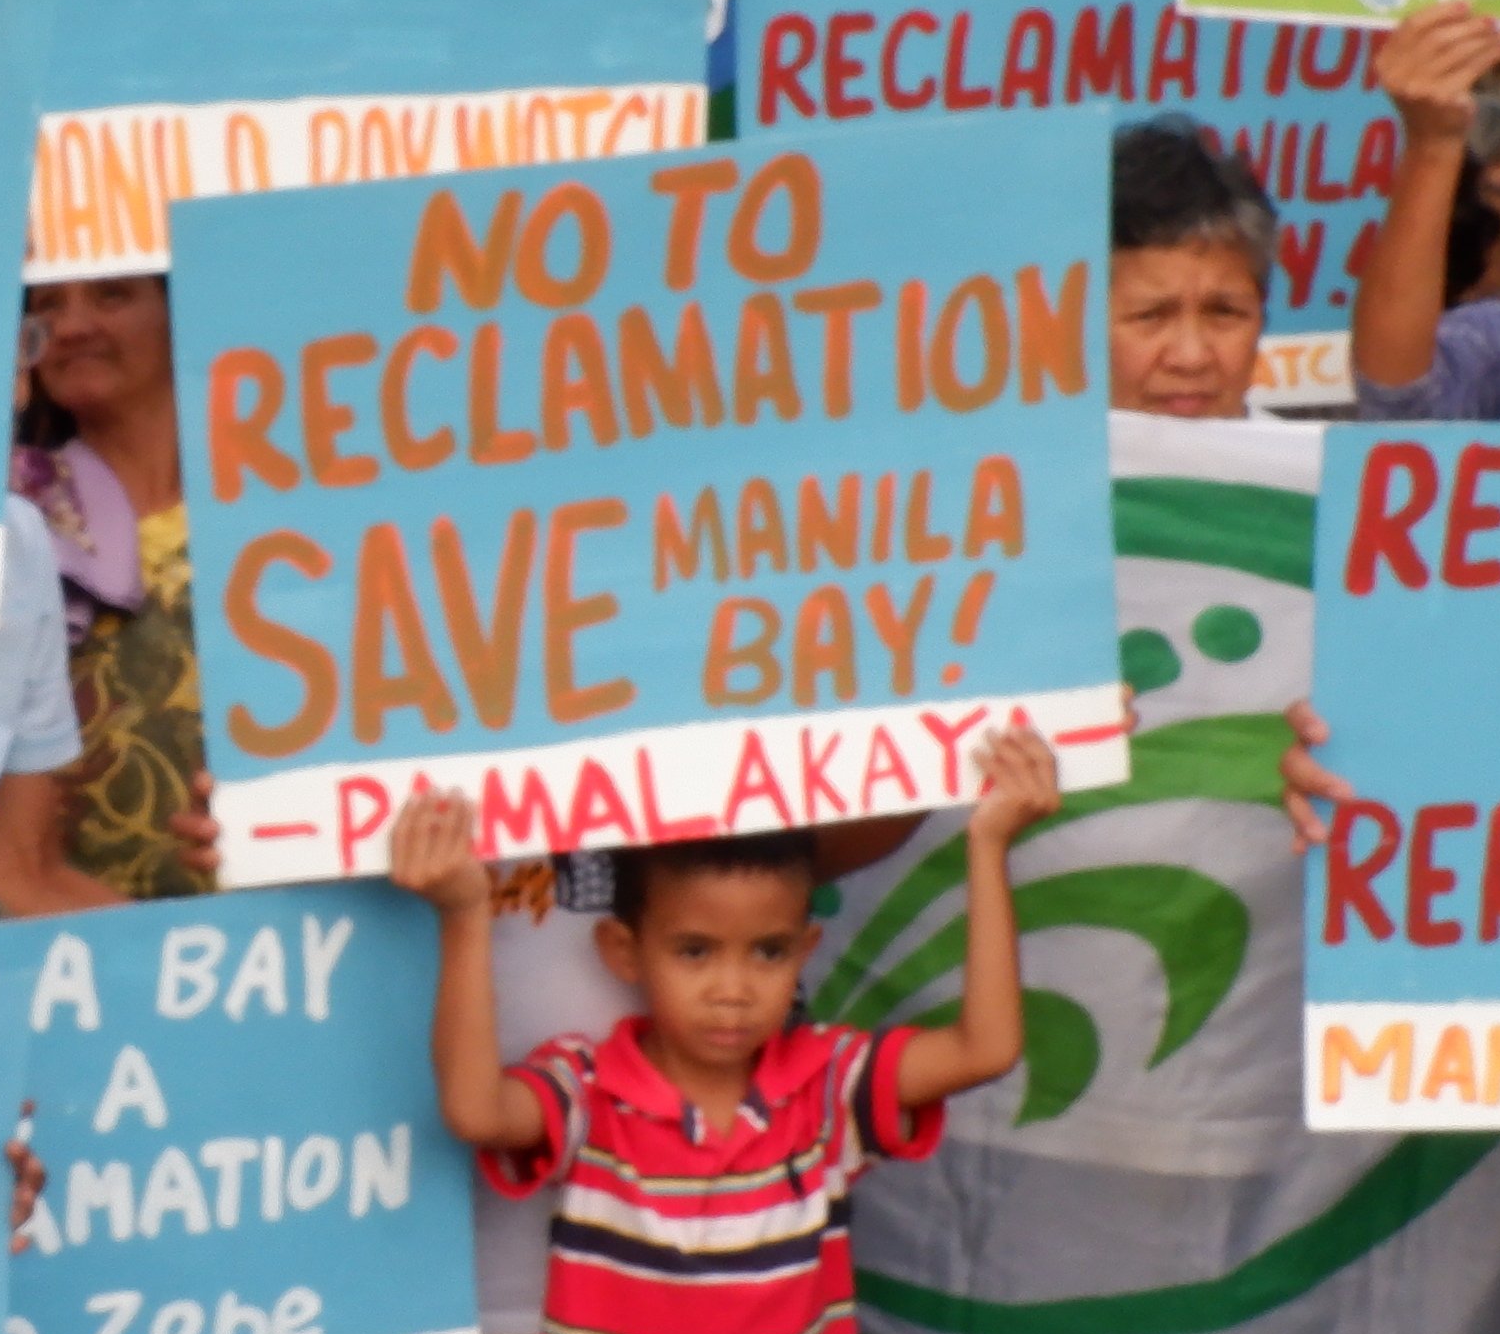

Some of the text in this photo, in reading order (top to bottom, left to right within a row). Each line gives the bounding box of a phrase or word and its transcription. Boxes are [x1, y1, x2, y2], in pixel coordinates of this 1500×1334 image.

[757, 2, 1397, 127] RECLAMATIO
[407, 150, 824, 316] NO TO
[207, 261, 1093, 504] RECLAMATION
[223, 455, 1027, 763] SAVE MANILA
[700, 570, 997, 710] BAY!
[155, 913, 354, 1025] BAY
[90, 1043, 170, 1135] A
